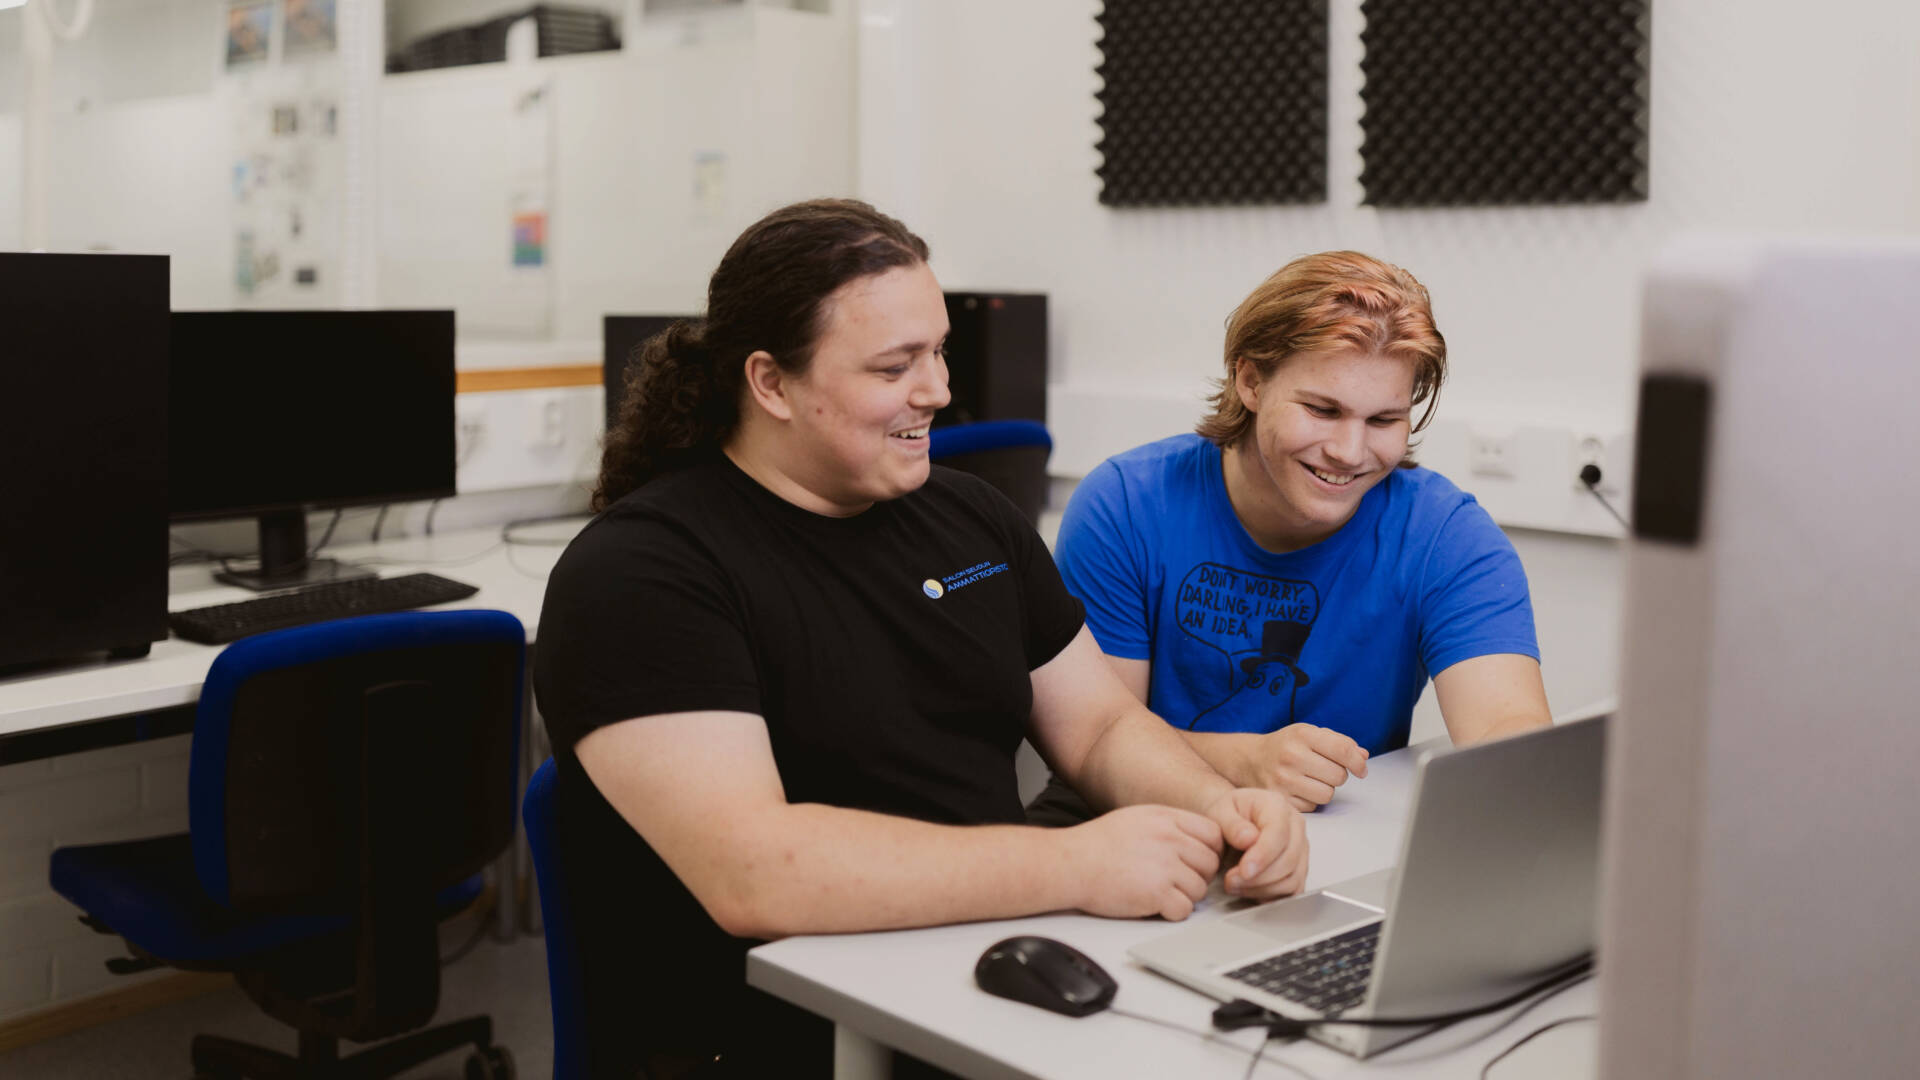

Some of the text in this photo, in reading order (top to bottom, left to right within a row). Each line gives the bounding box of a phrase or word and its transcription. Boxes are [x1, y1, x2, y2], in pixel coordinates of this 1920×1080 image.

[942, 571, 966, 583] SALON
[1254, 601, 1262, 617] I
[1265, 602, 1311, 621] HAVE
[1182, 609, 1254, 639] AN IDEA.
